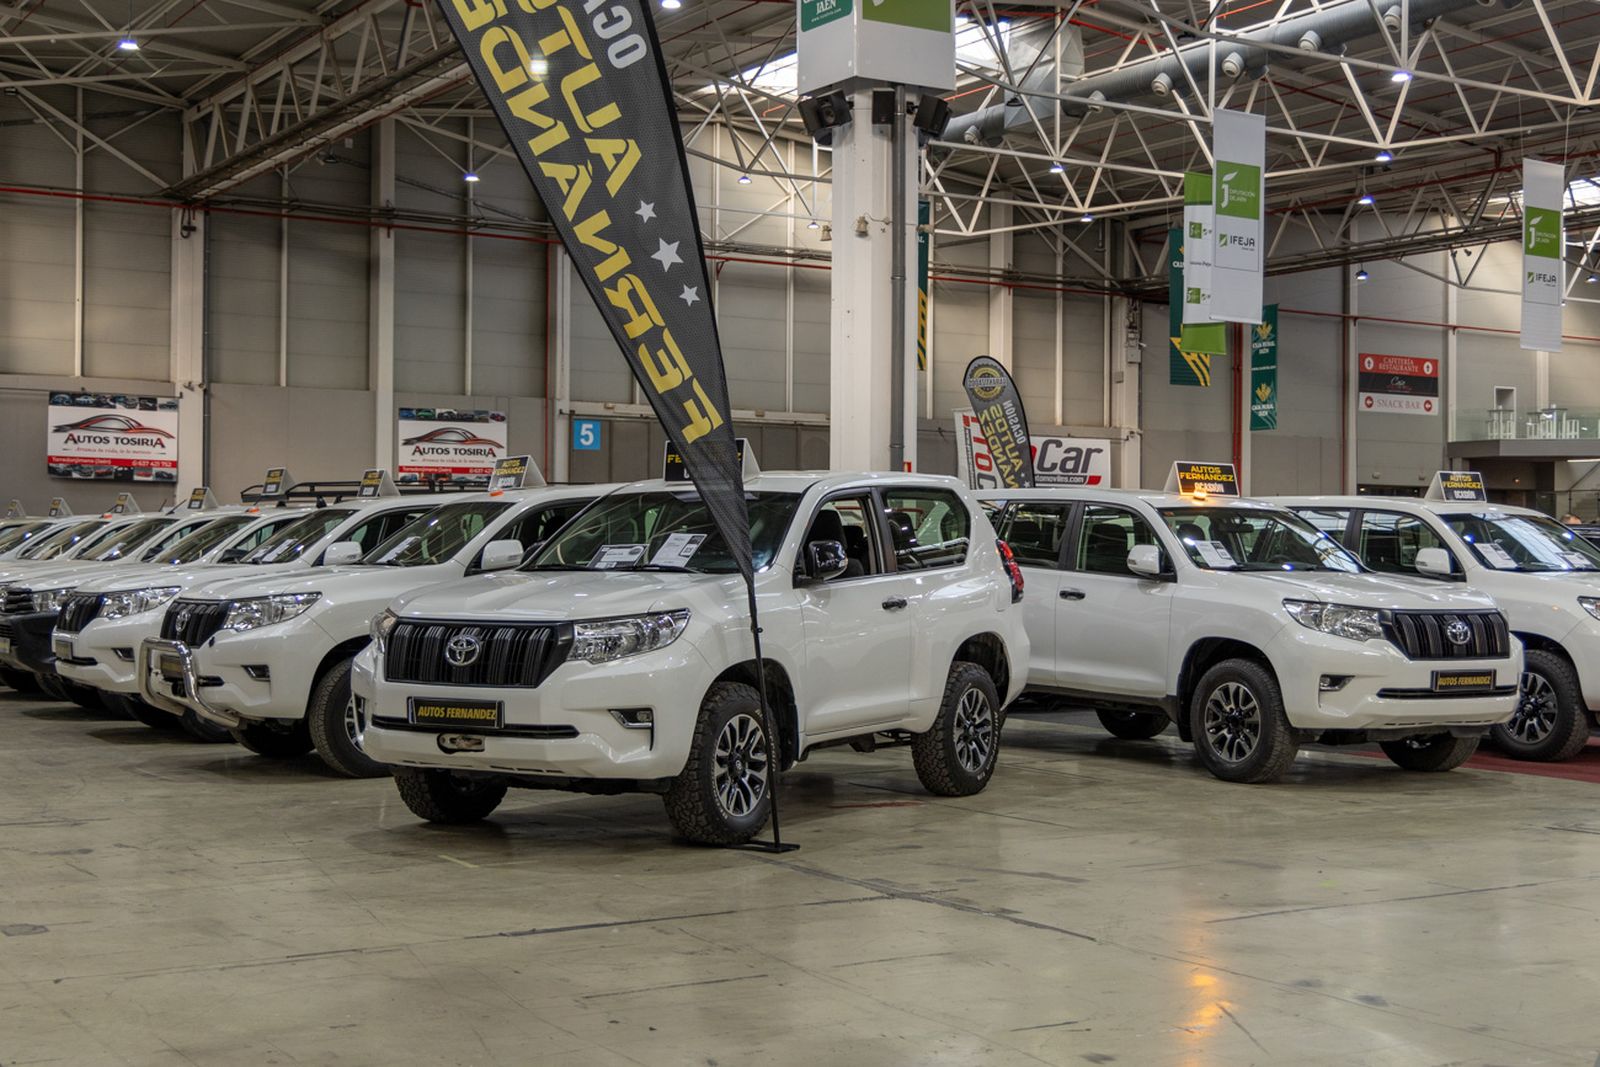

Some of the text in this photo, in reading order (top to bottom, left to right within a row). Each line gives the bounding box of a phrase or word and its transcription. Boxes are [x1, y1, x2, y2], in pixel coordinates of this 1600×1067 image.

[1230, 235, 1255, 247] IFEJA
[1535, 272, 1557, 284] IFEJA
[1377, 400, 1421, 410] SNACK BAR
[580, 423, 594, 446] 5
[1191, 465, 1222, 473] AUTOS
[417, 706, 497, 720] AUTOS FERNANDEZ
